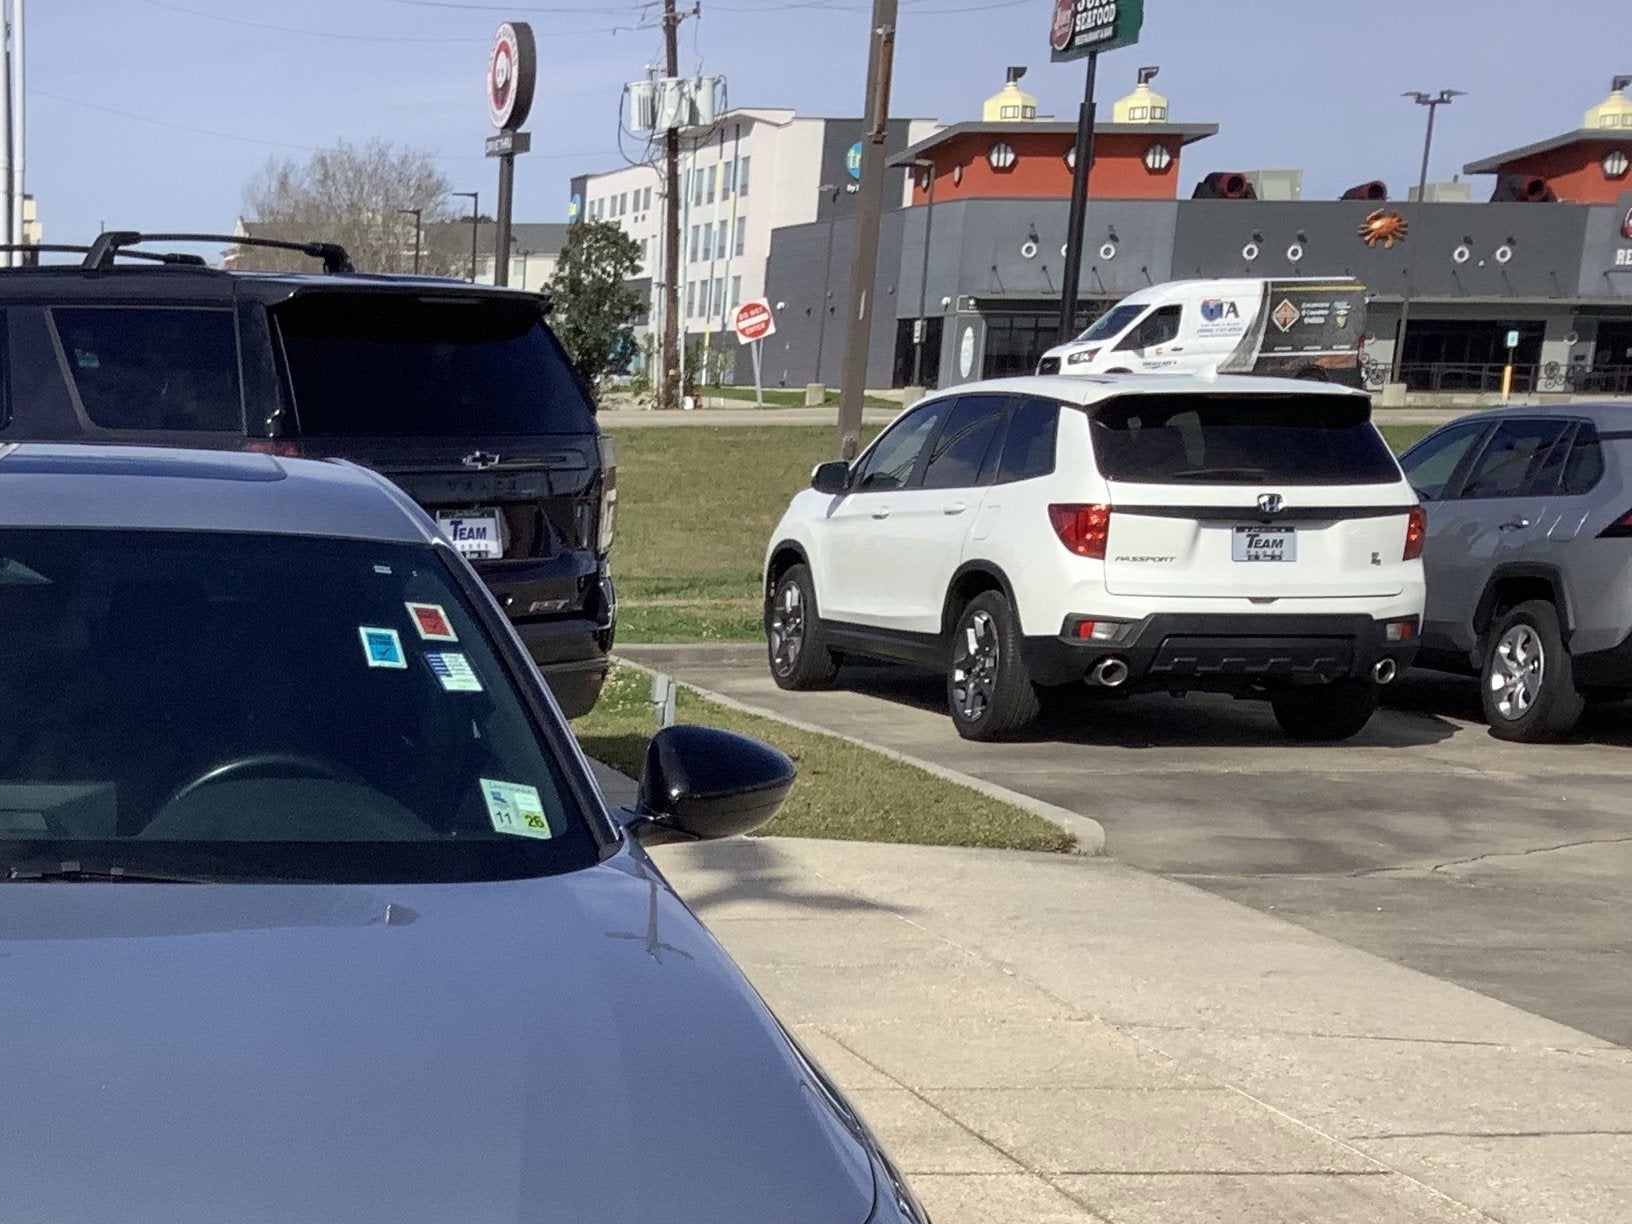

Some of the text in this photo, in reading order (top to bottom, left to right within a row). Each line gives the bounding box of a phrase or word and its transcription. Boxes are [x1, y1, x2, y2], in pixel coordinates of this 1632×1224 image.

[1075, 3, 1116, 32] SEAFOOD
[449, 520, 487, 541] TEAM
[1246, 533, 1285, 549] TEAM
[1115, 555, 1177, 563] PASSPORT
[496, 811, 545, 828] 11 26
